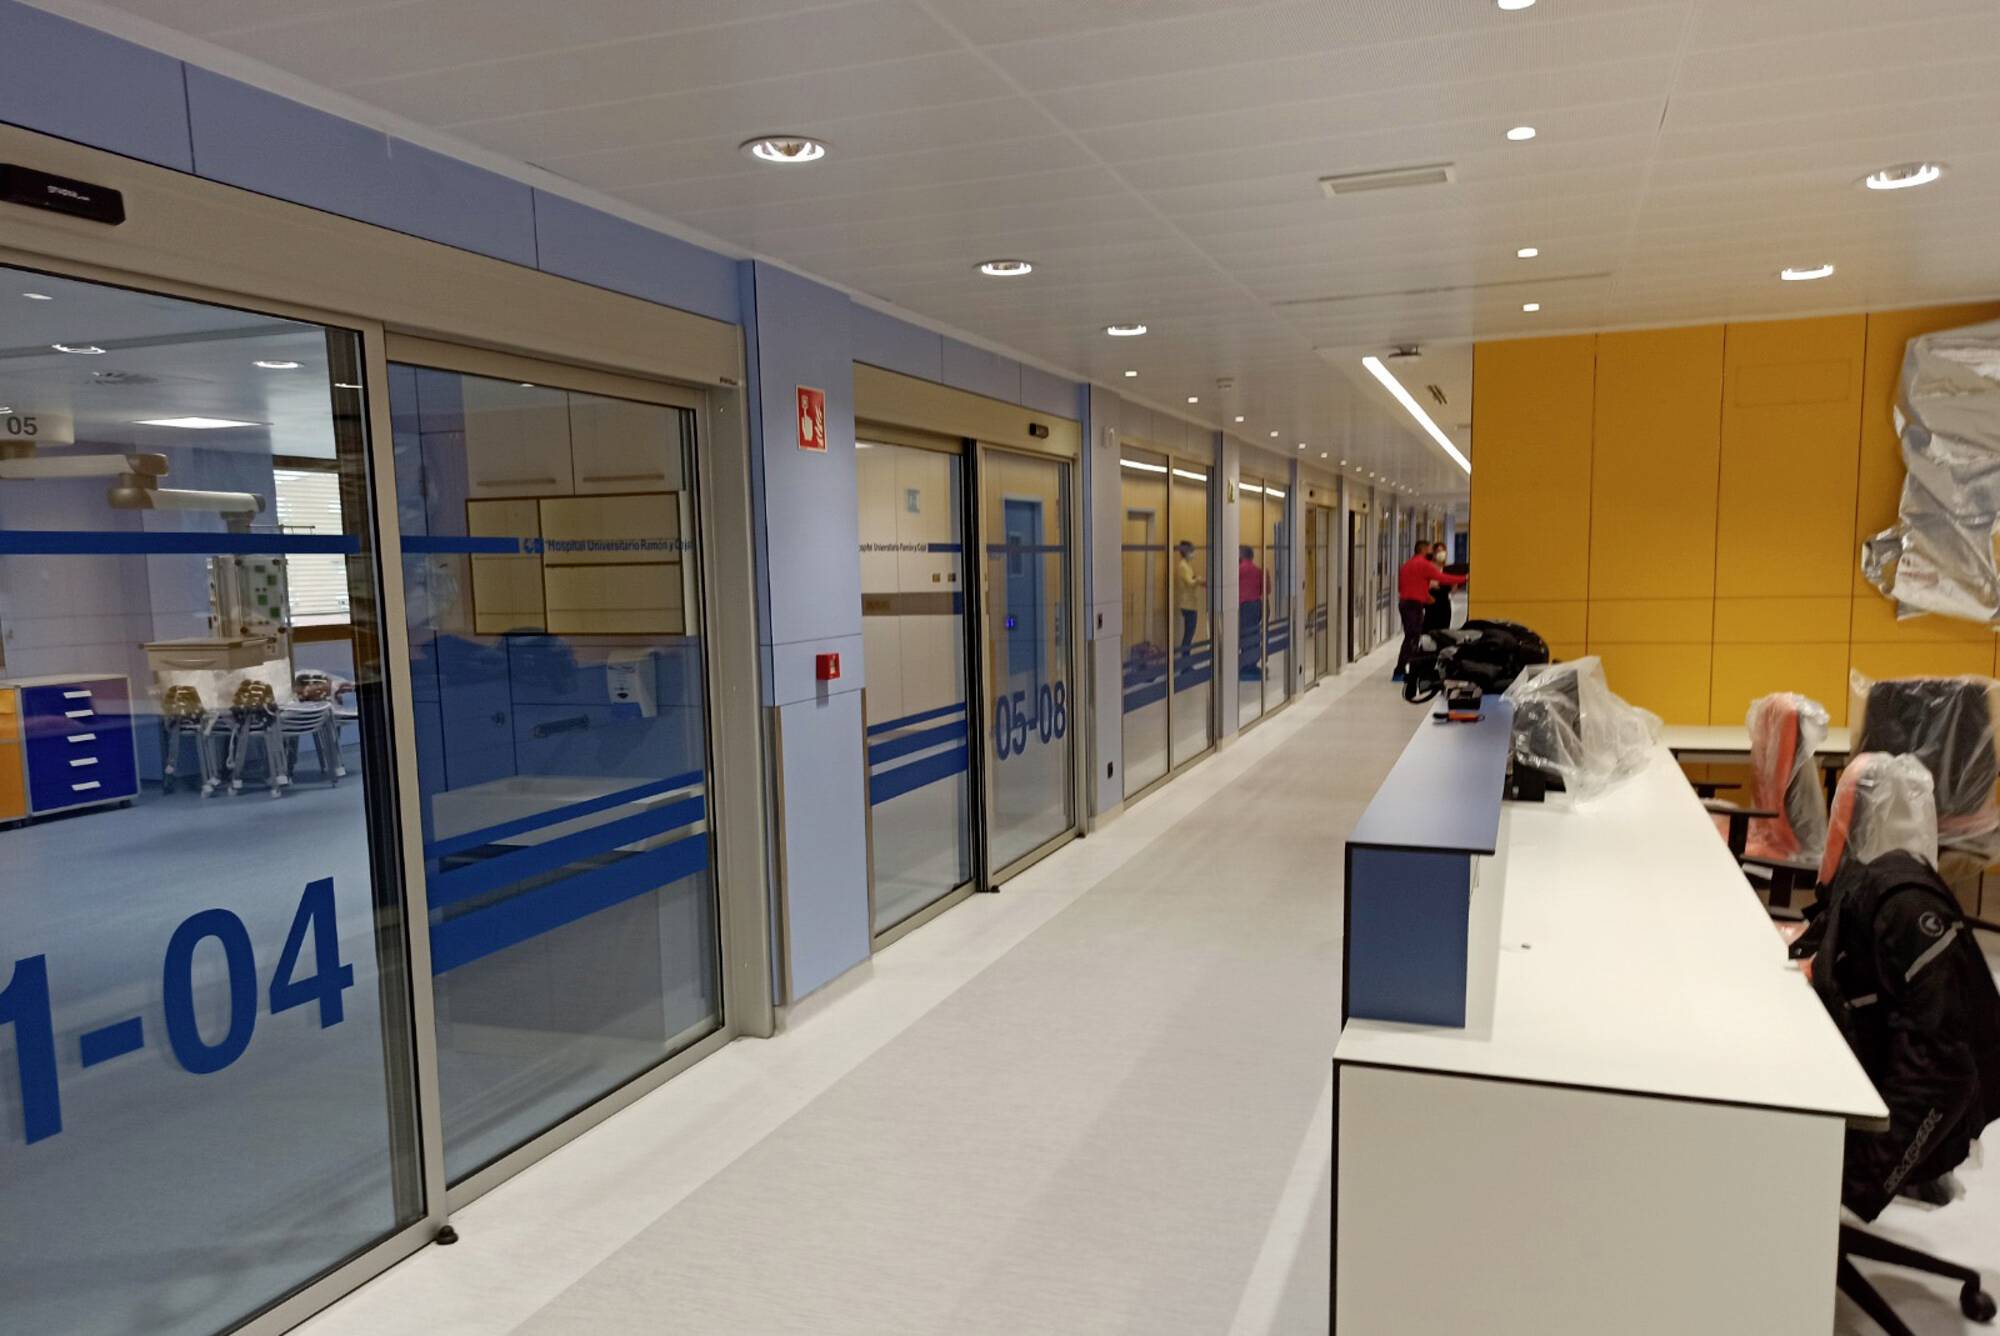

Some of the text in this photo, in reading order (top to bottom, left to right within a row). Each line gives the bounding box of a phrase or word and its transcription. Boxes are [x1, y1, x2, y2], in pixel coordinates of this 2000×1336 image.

[7, 416, 38, 436] 05
[548, 539, 586, 552] Hospital
[587, 539, 640, 551] Universitario
[995, 680, 1066, 760] 05-08
